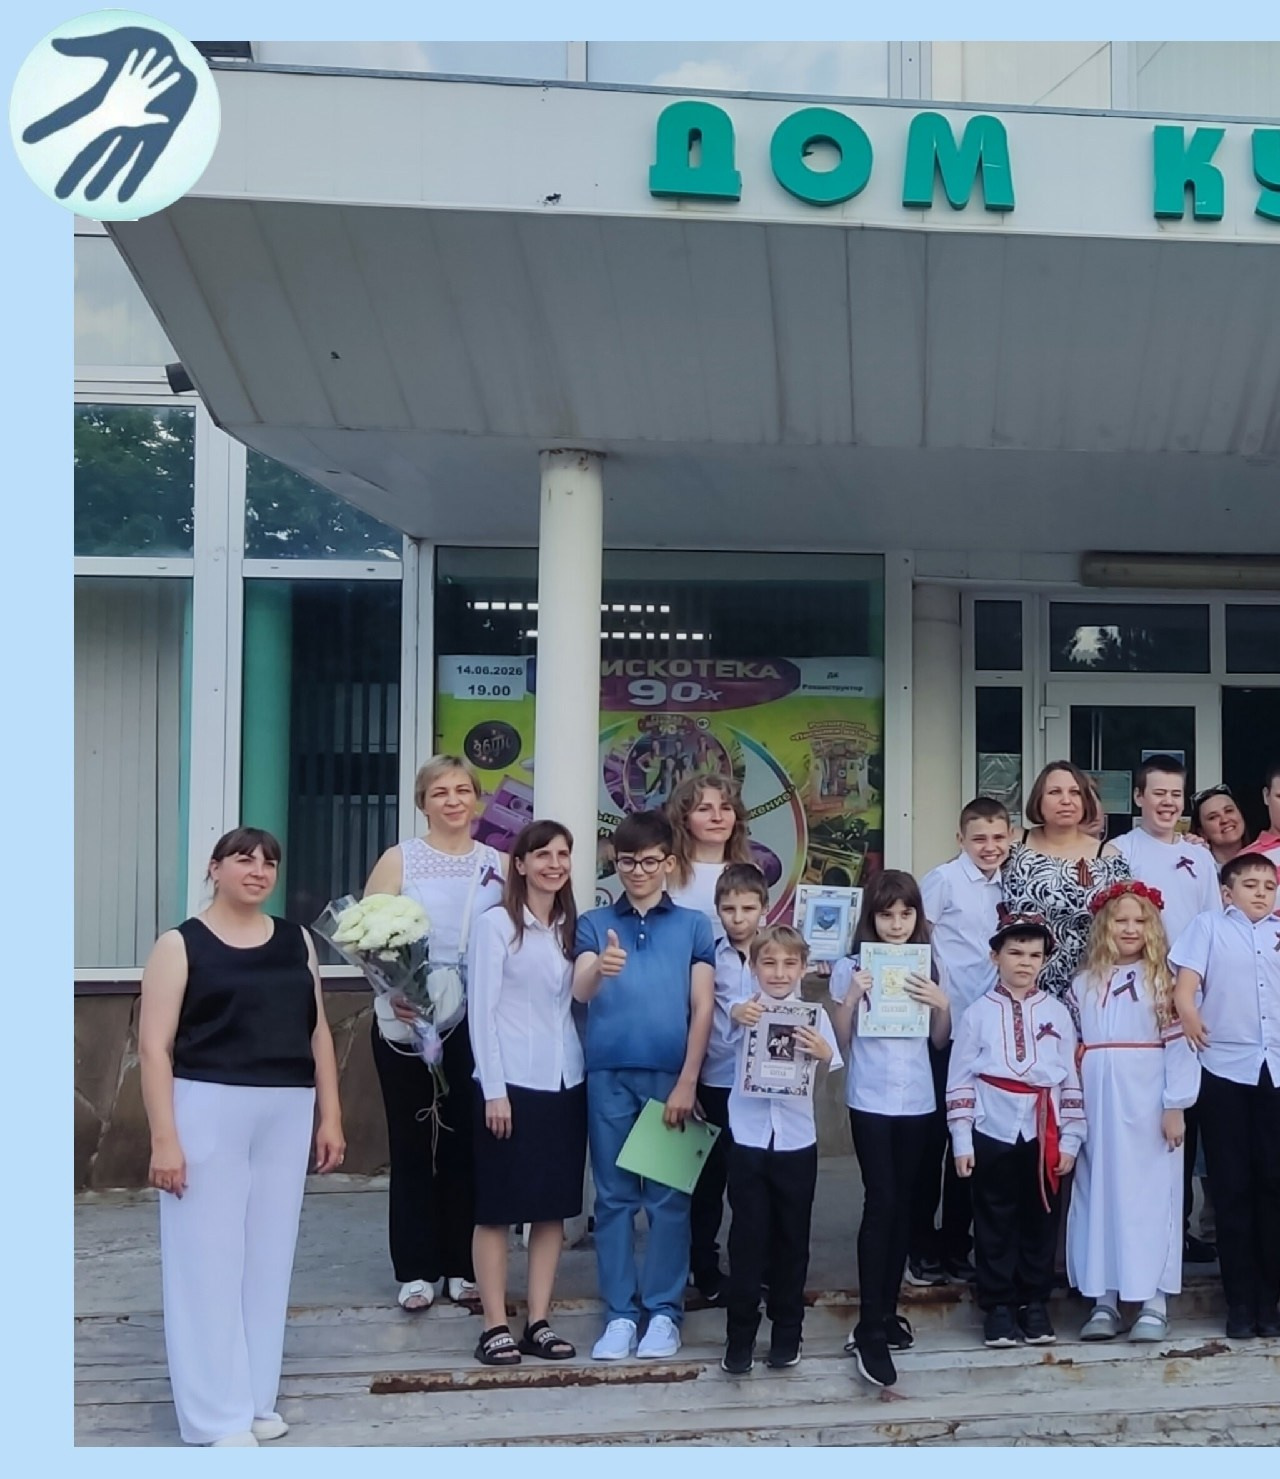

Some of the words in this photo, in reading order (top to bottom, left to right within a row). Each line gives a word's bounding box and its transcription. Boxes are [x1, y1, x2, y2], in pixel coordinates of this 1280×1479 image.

[649, 101, 1015, 212] ДОМ
[456, 665, 524, 676] 14.06.2026
[601, 659, 783, 680] ИСКОТЕКА
[468, 684, 511, 696] 19.00
